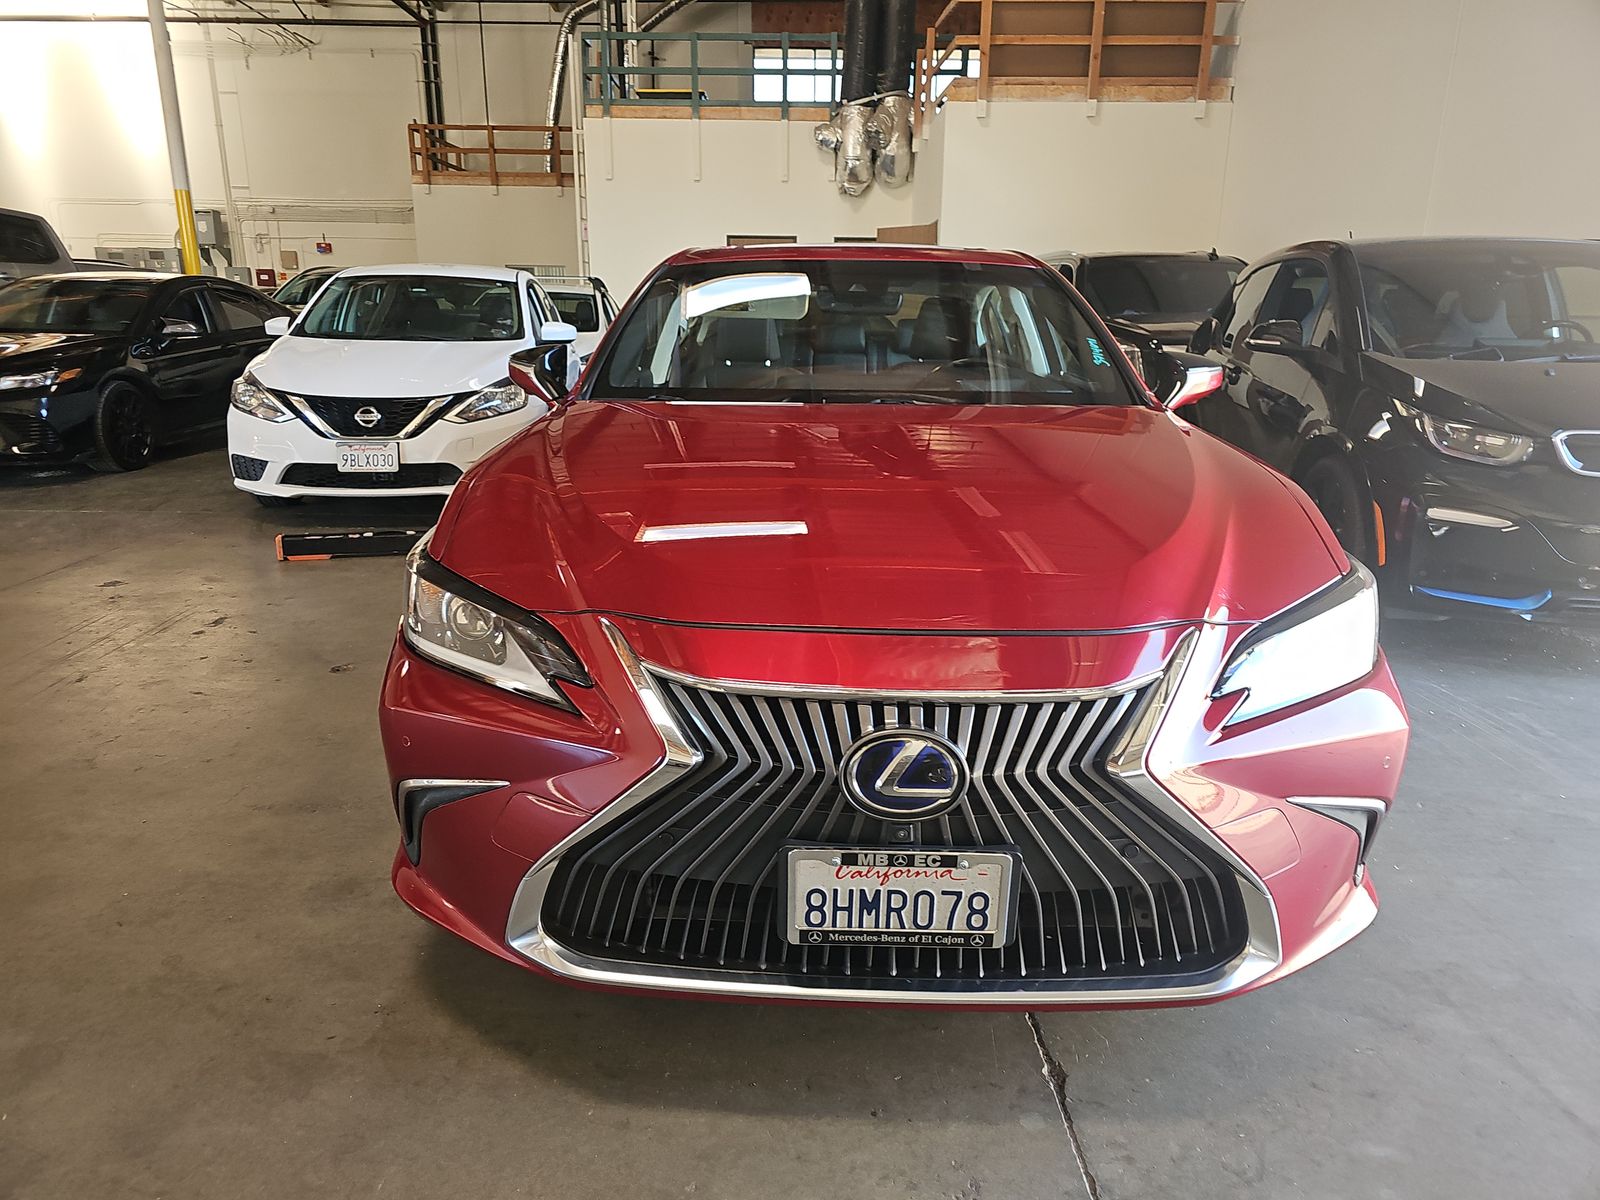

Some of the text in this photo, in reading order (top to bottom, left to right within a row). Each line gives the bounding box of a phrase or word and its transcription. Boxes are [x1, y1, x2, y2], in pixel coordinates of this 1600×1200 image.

[341, 453, 394, 467] 9BLX030
[857, 854, 942, 867] MB EC
[834, 865, 968, 886] California
[804, 888, 990, 932] 8HMR078
[828, 933, 965, 946] Mercedes-Benz of El Cajon
